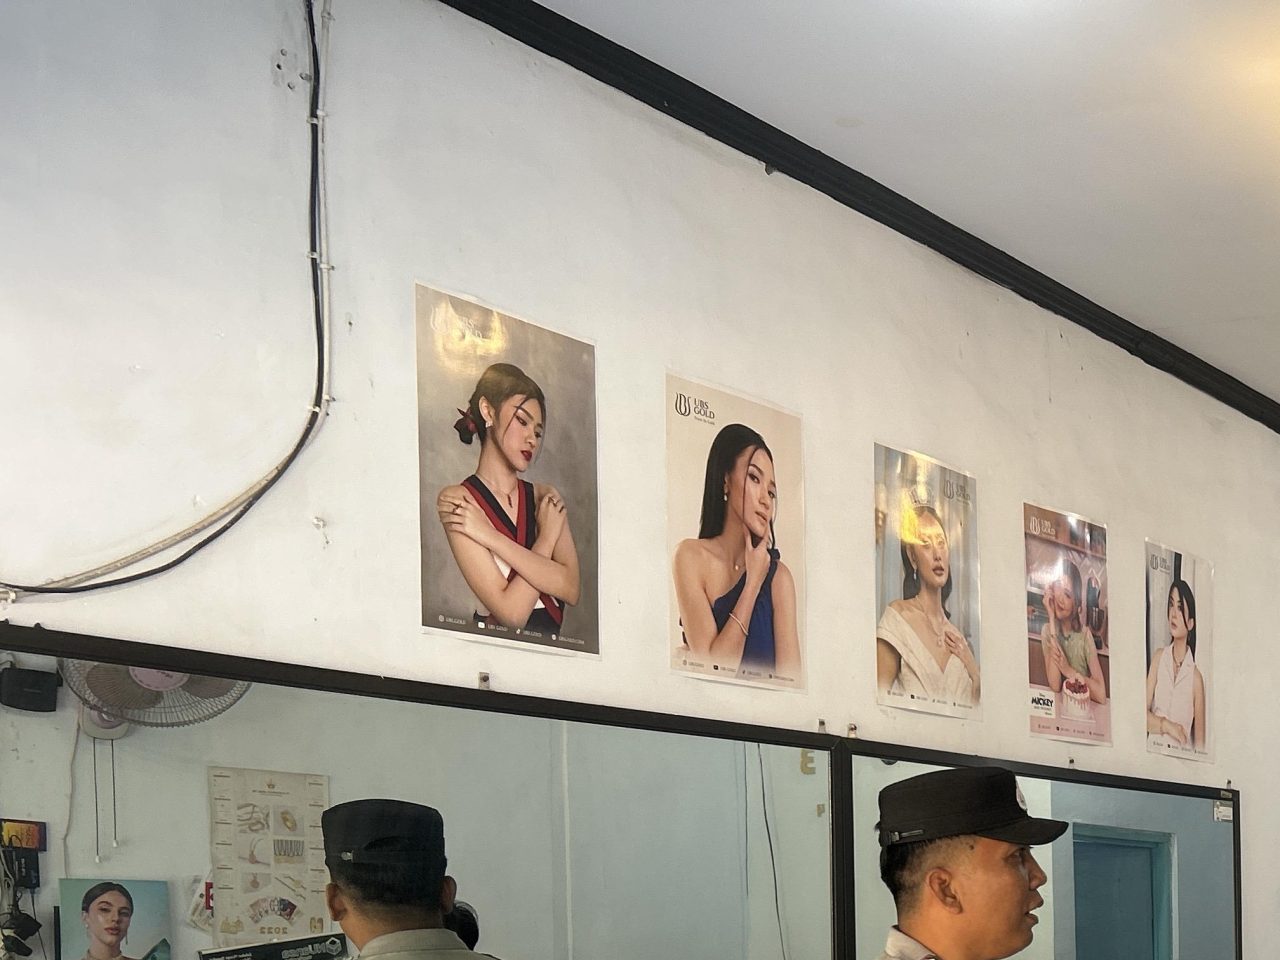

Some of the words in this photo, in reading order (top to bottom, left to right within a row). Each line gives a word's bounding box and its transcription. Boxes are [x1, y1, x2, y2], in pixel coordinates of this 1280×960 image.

[694, 398, 709, 409] UBS
[694, 406, 715, 419] GOLD
[1031, 696, 1054, 708] MICKEY
